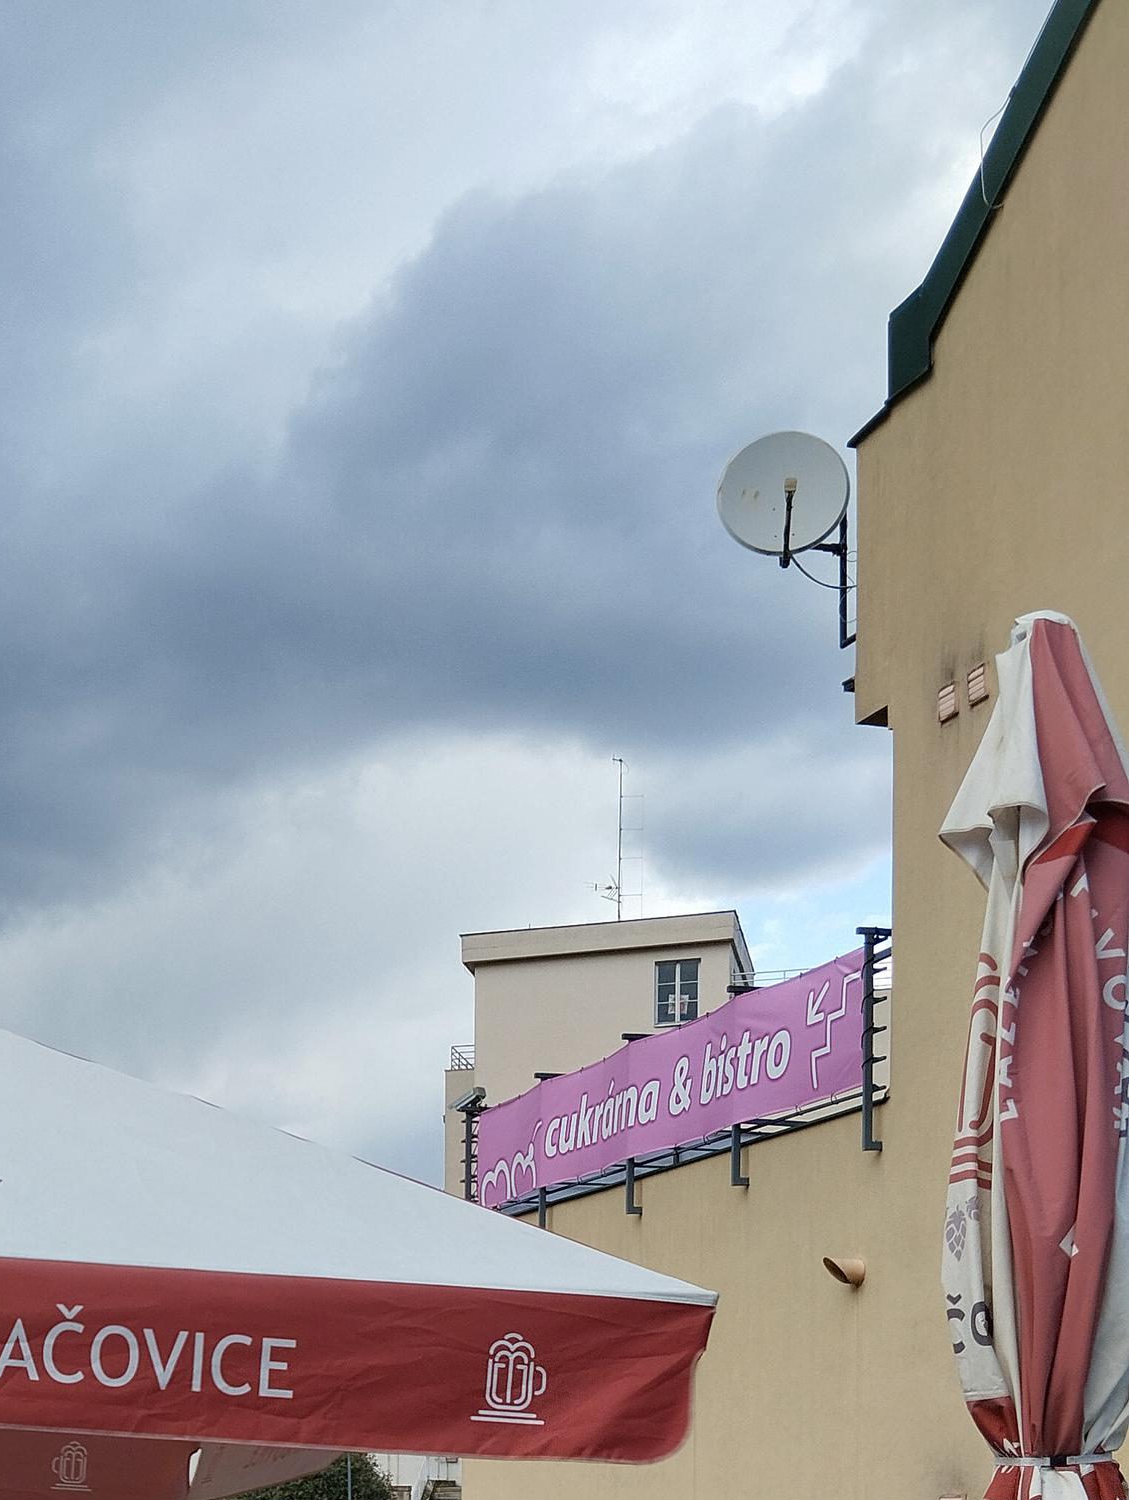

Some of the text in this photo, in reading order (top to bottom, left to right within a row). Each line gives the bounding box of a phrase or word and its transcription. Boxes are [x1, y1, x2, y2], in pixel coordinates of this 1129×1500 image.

[544, 1029, 791, 1159] cukrárna & bistro
